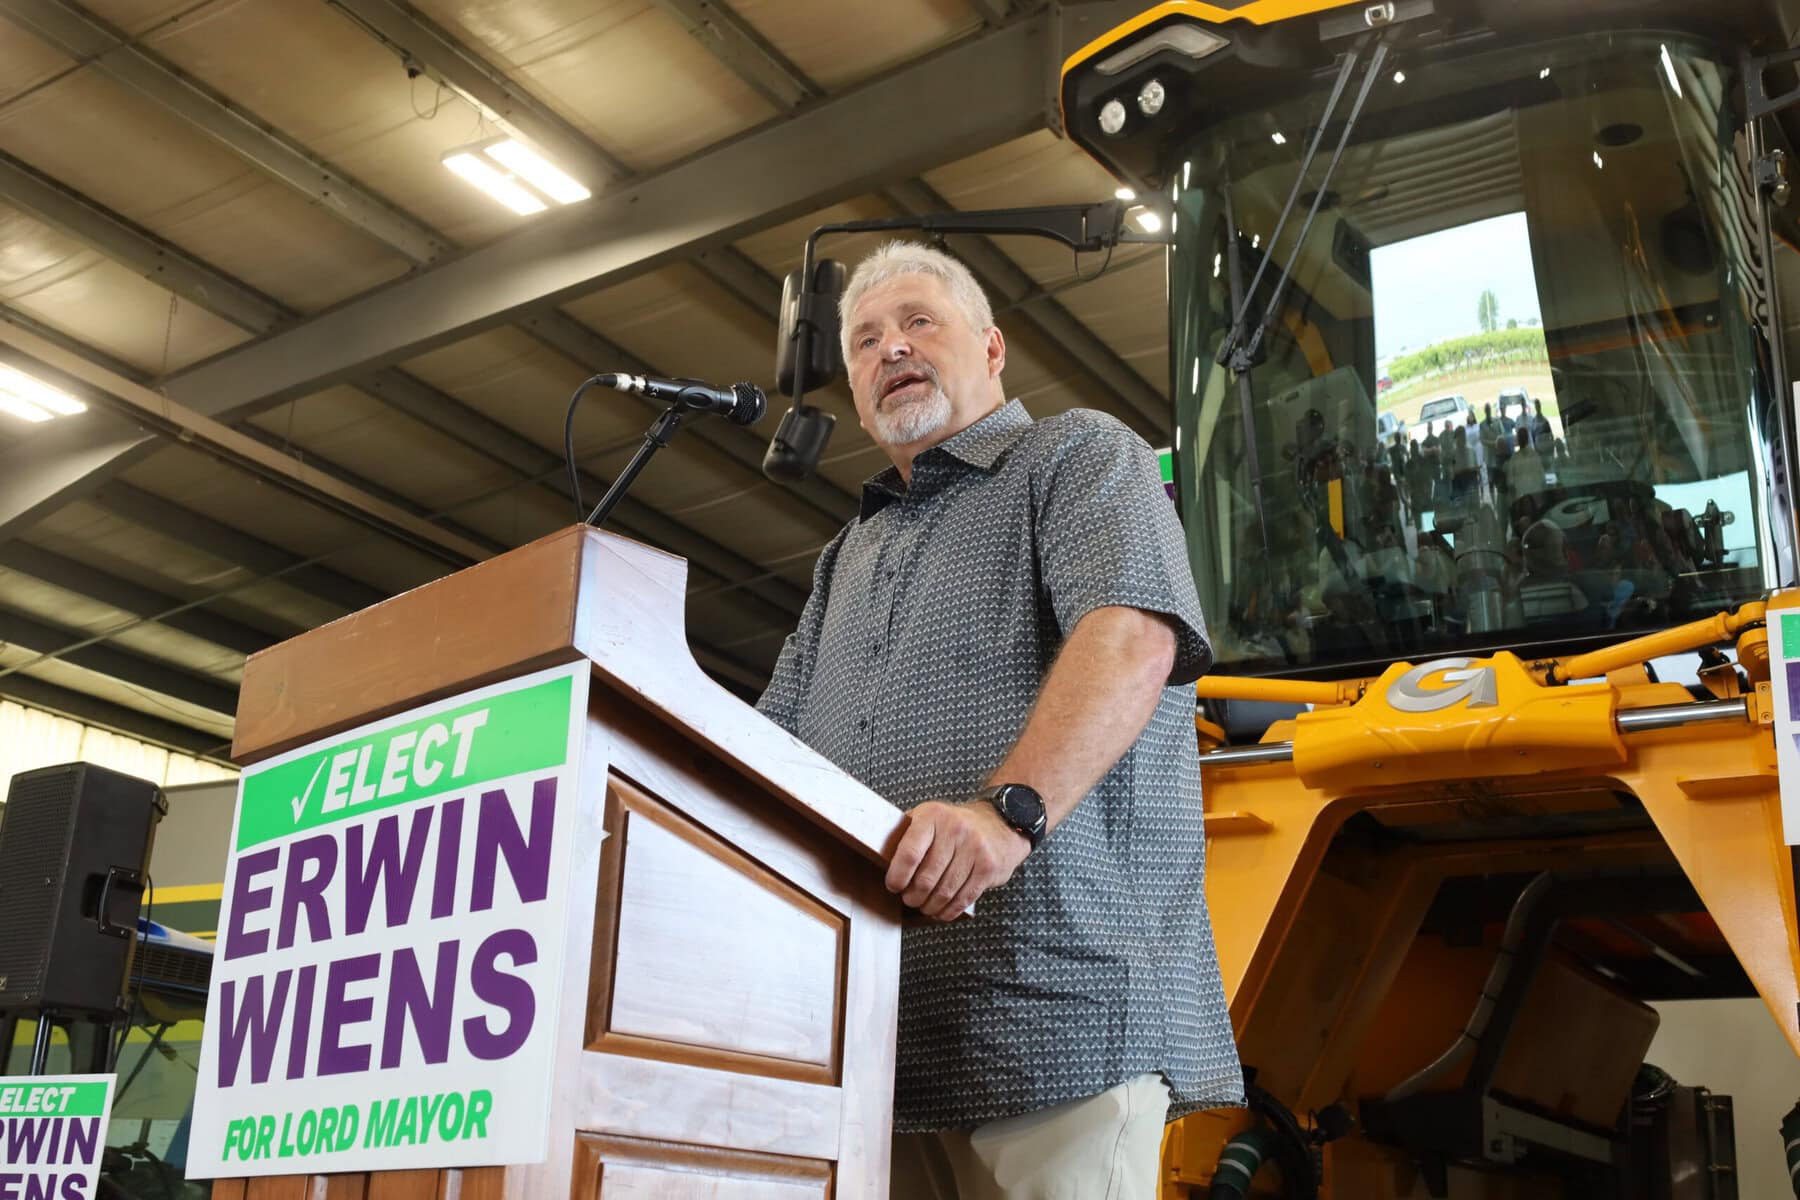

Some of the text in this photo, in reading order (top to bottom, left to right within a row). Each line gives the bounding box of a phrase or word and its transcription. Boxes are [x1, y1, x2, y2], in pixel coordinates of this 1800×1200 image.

[320, 708, 490, 814] ELECT
[226, 779, 556, 960] ERWIN
[219, 929, 537, 1087] WIENS
[0, 1087, 76, 1113] ELECT
[0, 1118, 101, 1165] WIN
[223, 1090, 493, 1161] FOR LORD MAYOR
